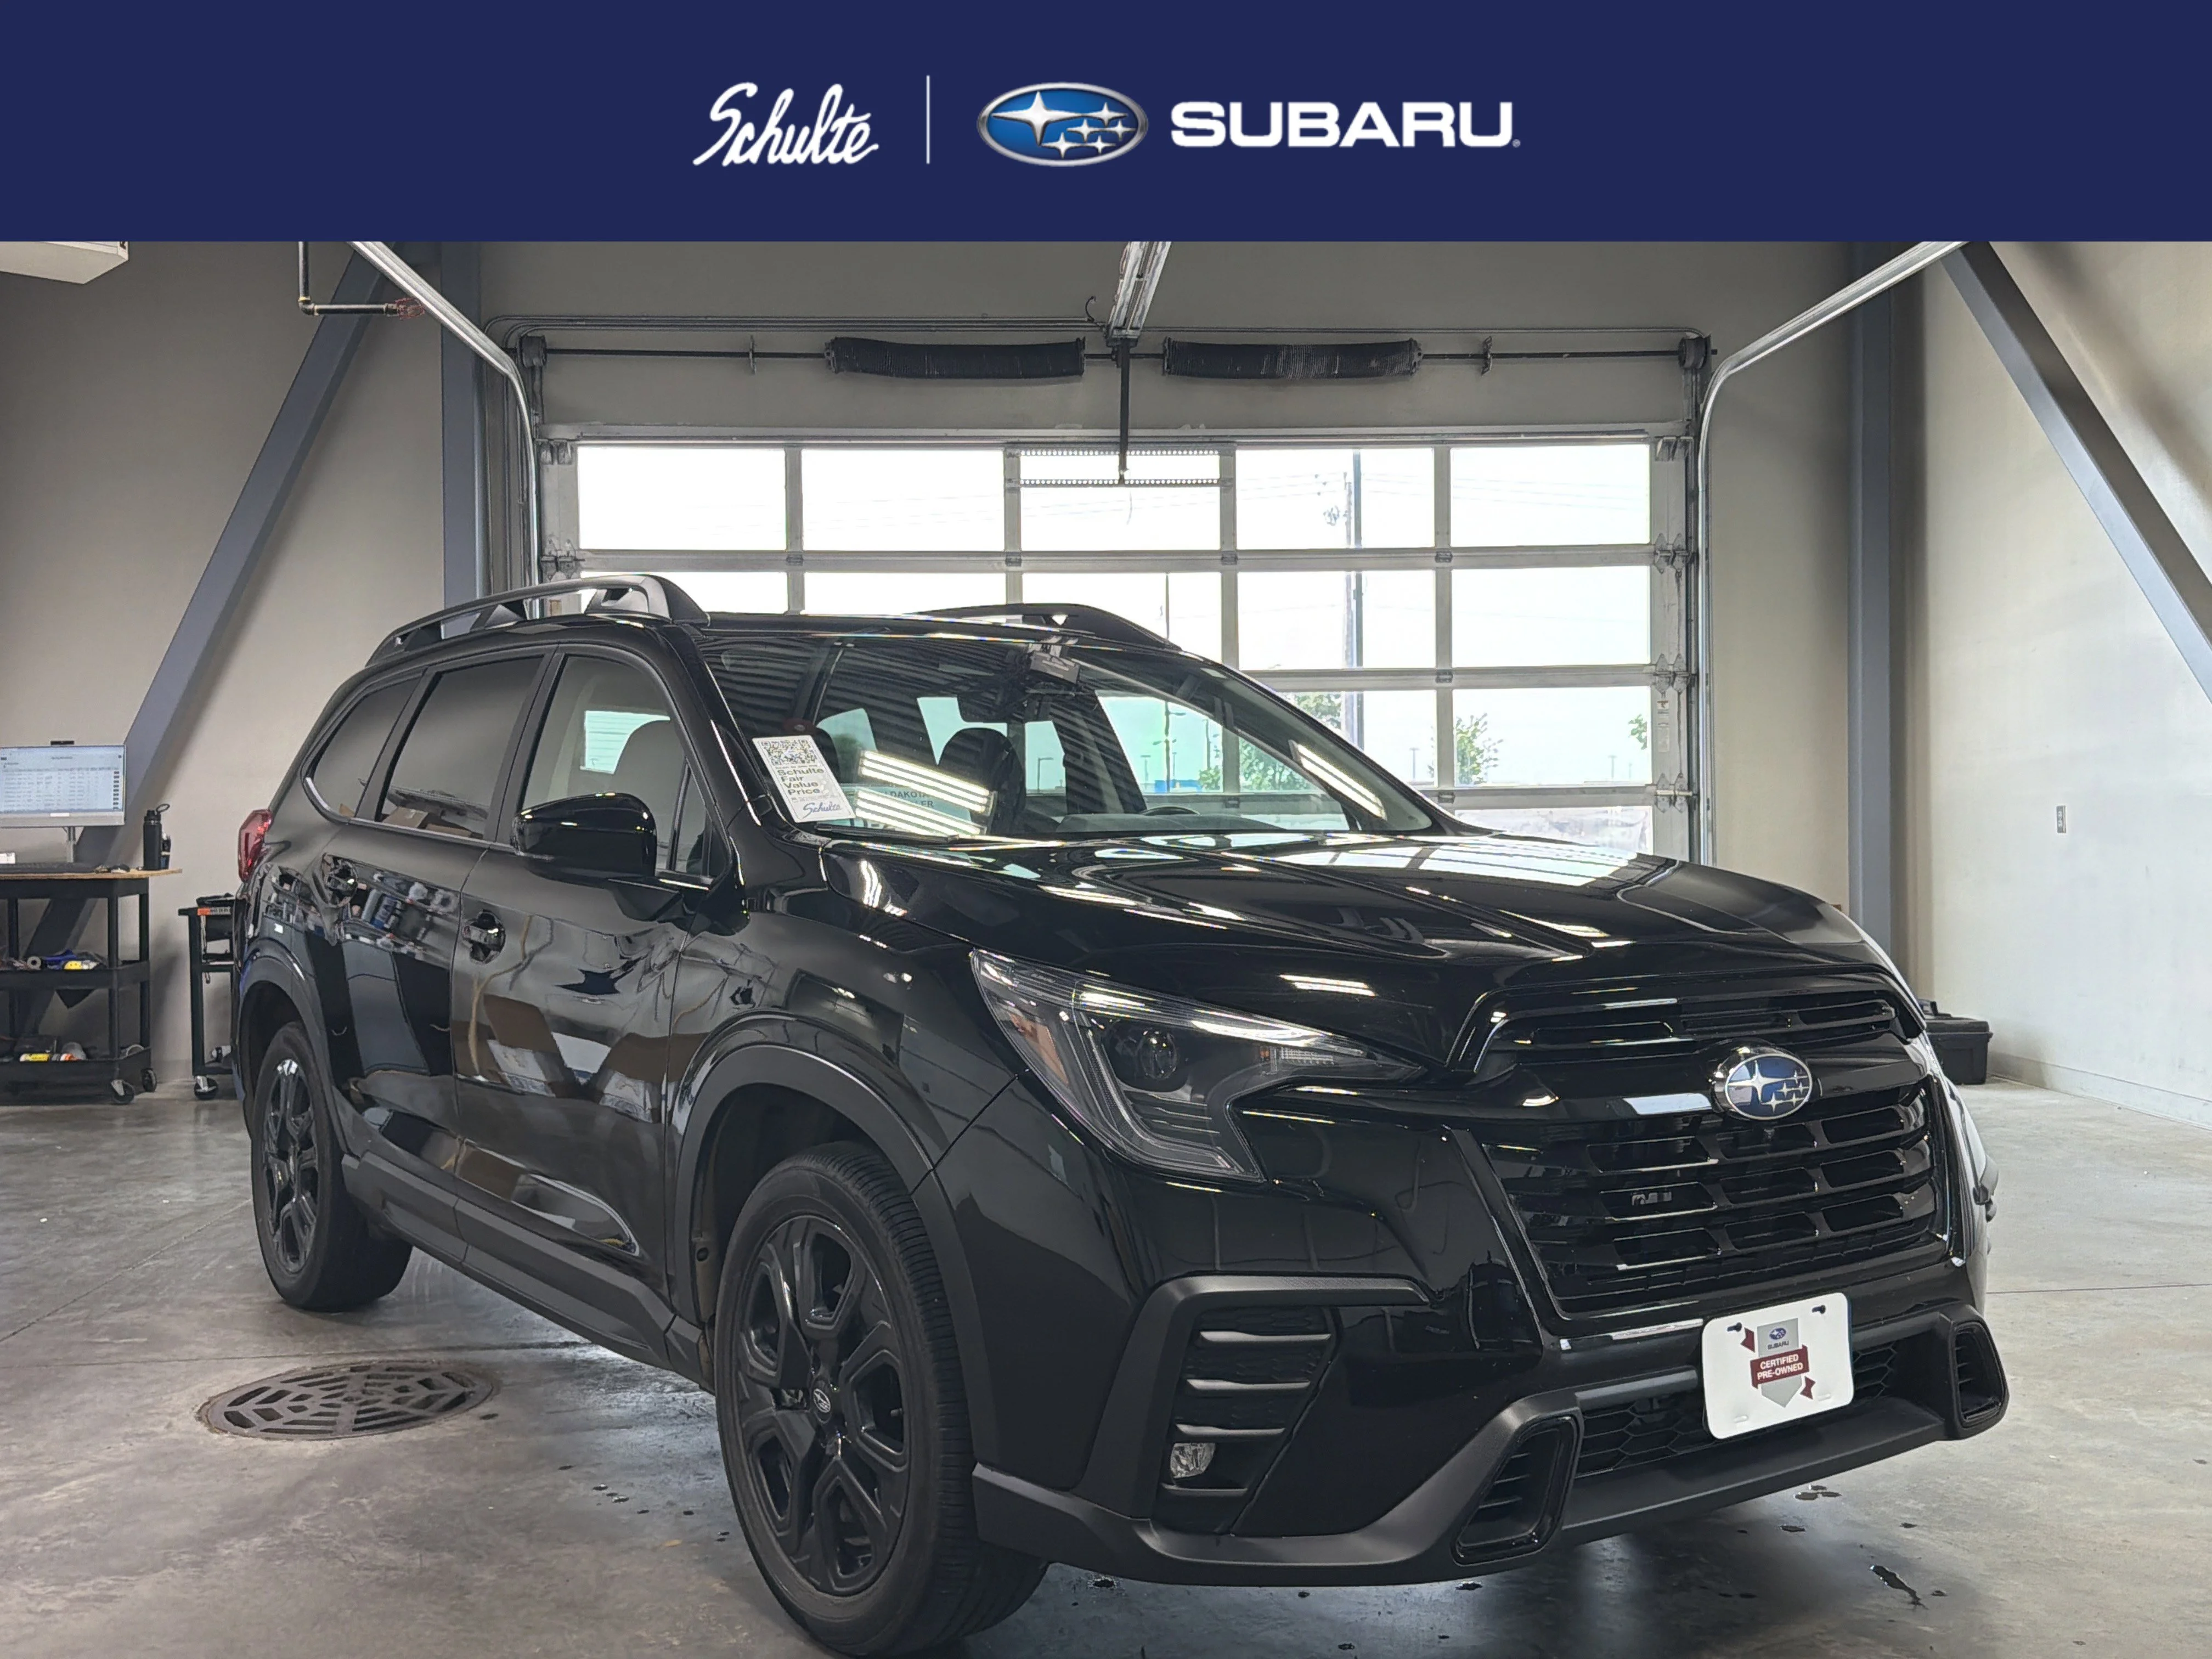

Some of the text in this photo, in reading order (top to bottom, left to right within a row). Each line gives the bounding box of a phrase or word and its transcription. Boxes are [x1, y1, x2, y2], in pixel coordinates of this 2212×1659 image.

[777, 768, 825, 776] Schulte
[802, 801, 842, 819] Schulte
[1767, 1340, 1790, 1350] SUBARU
[1759, 1353, 1799, 1370] CERTIFIED
[1757, 1362, 1803, 1380] PRE-OWNED
